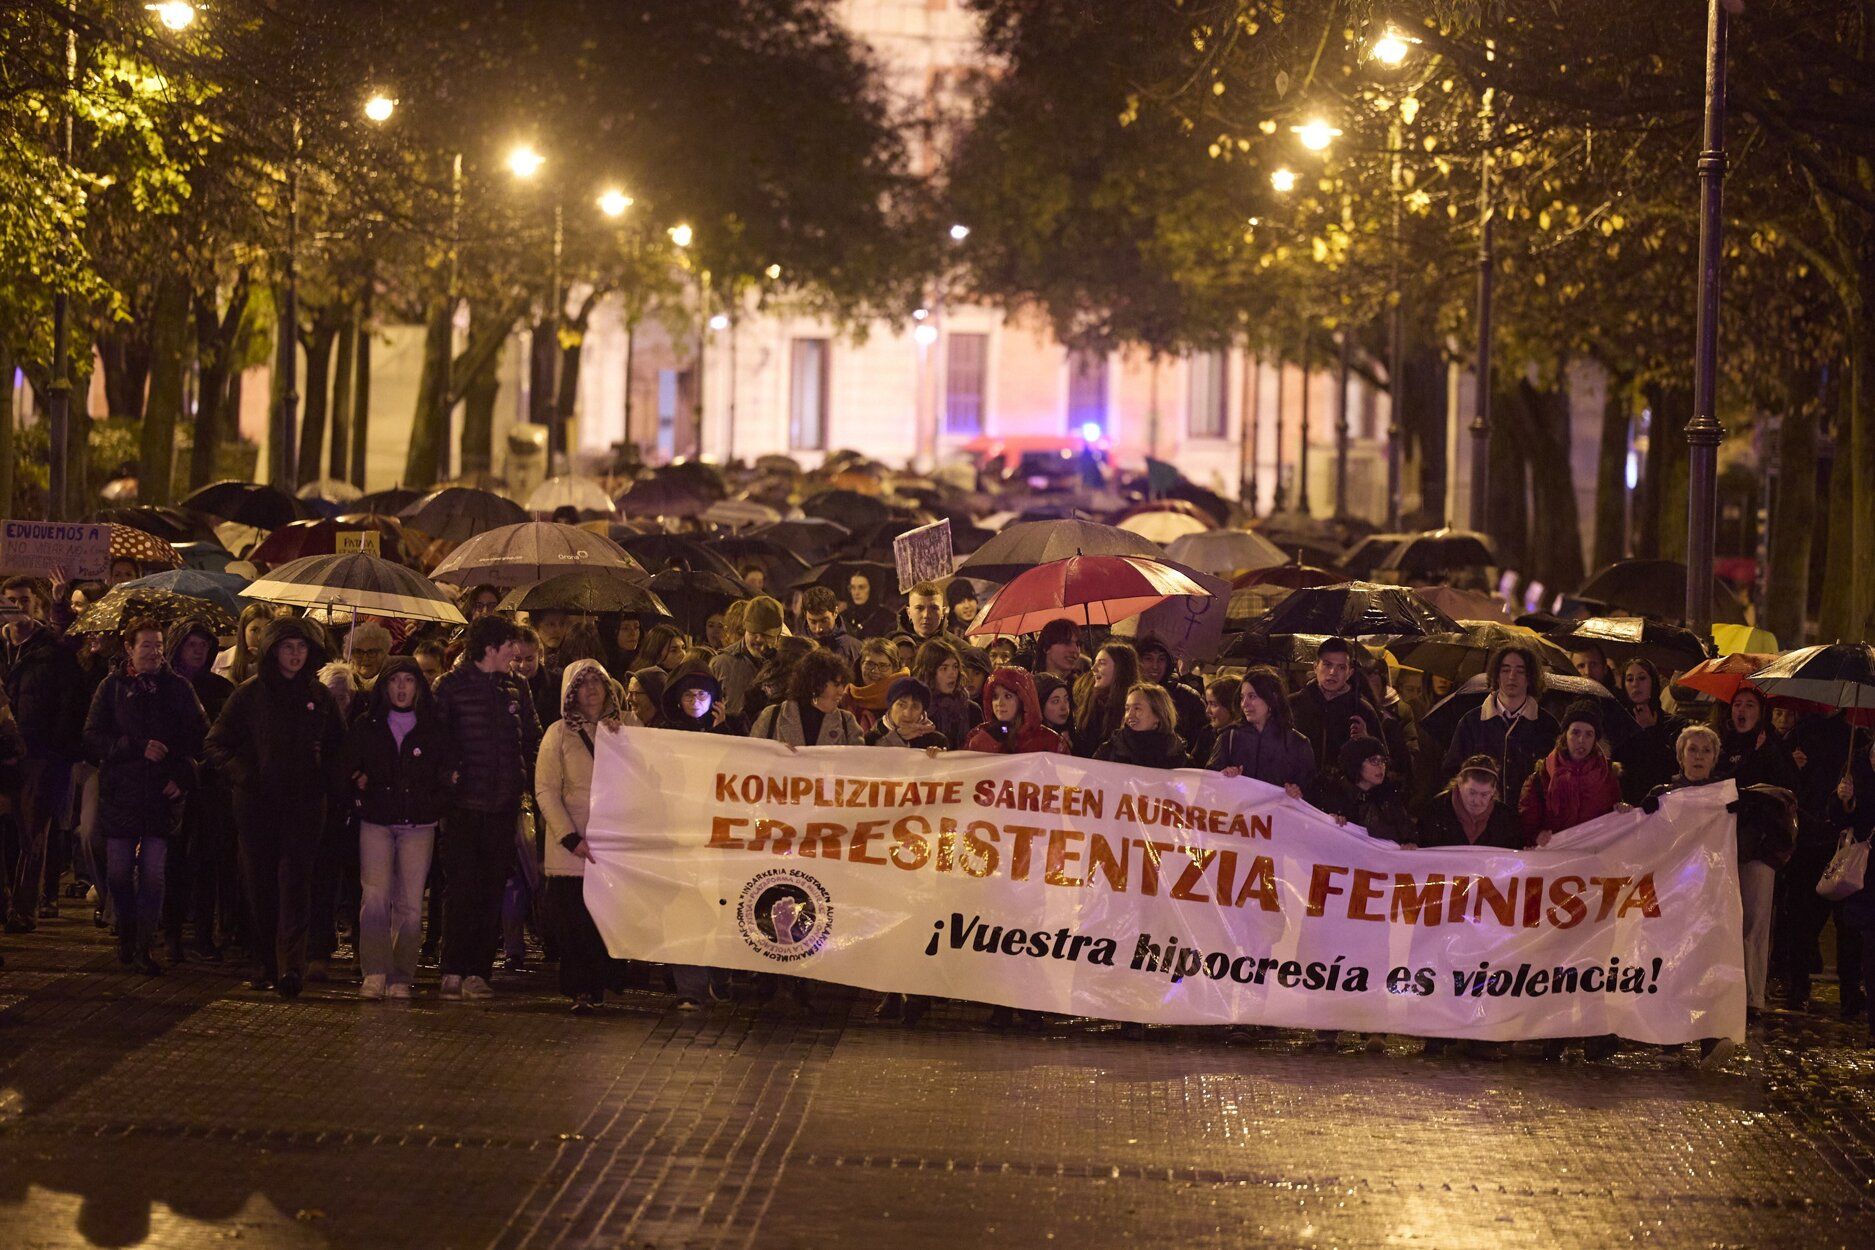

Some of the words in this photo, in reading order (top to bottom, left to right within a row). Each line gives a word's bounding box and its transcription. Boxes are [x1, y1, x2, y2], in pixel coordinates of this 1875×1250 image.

[6, 523, 84, 541] EDUQUEMOS
[89, 528, 99, 543] A
[715, 772, 964, 808] KONPLIZITATE
[973, 779, 1104, 819] SAREEN
[1115, 793, 1274, 841] AURREAN
[703, 815, 1281, 913] ERRESISTENTZIA
[1306, 863, 1663, 930] FEMINISTA
[743, 868, 787, 895] INDARKERIA
[790, 869, 831, 903] SEXISTAREN
[736, 901, 761, 953] PLATAFORMA
[925, 912, 1117, 967] ¡Vuestra
[1129, 932, 1369, 994] hipocresía
[1386, 961, 1436, 996] es
[1452, 957, 1663, 998] violencia!
